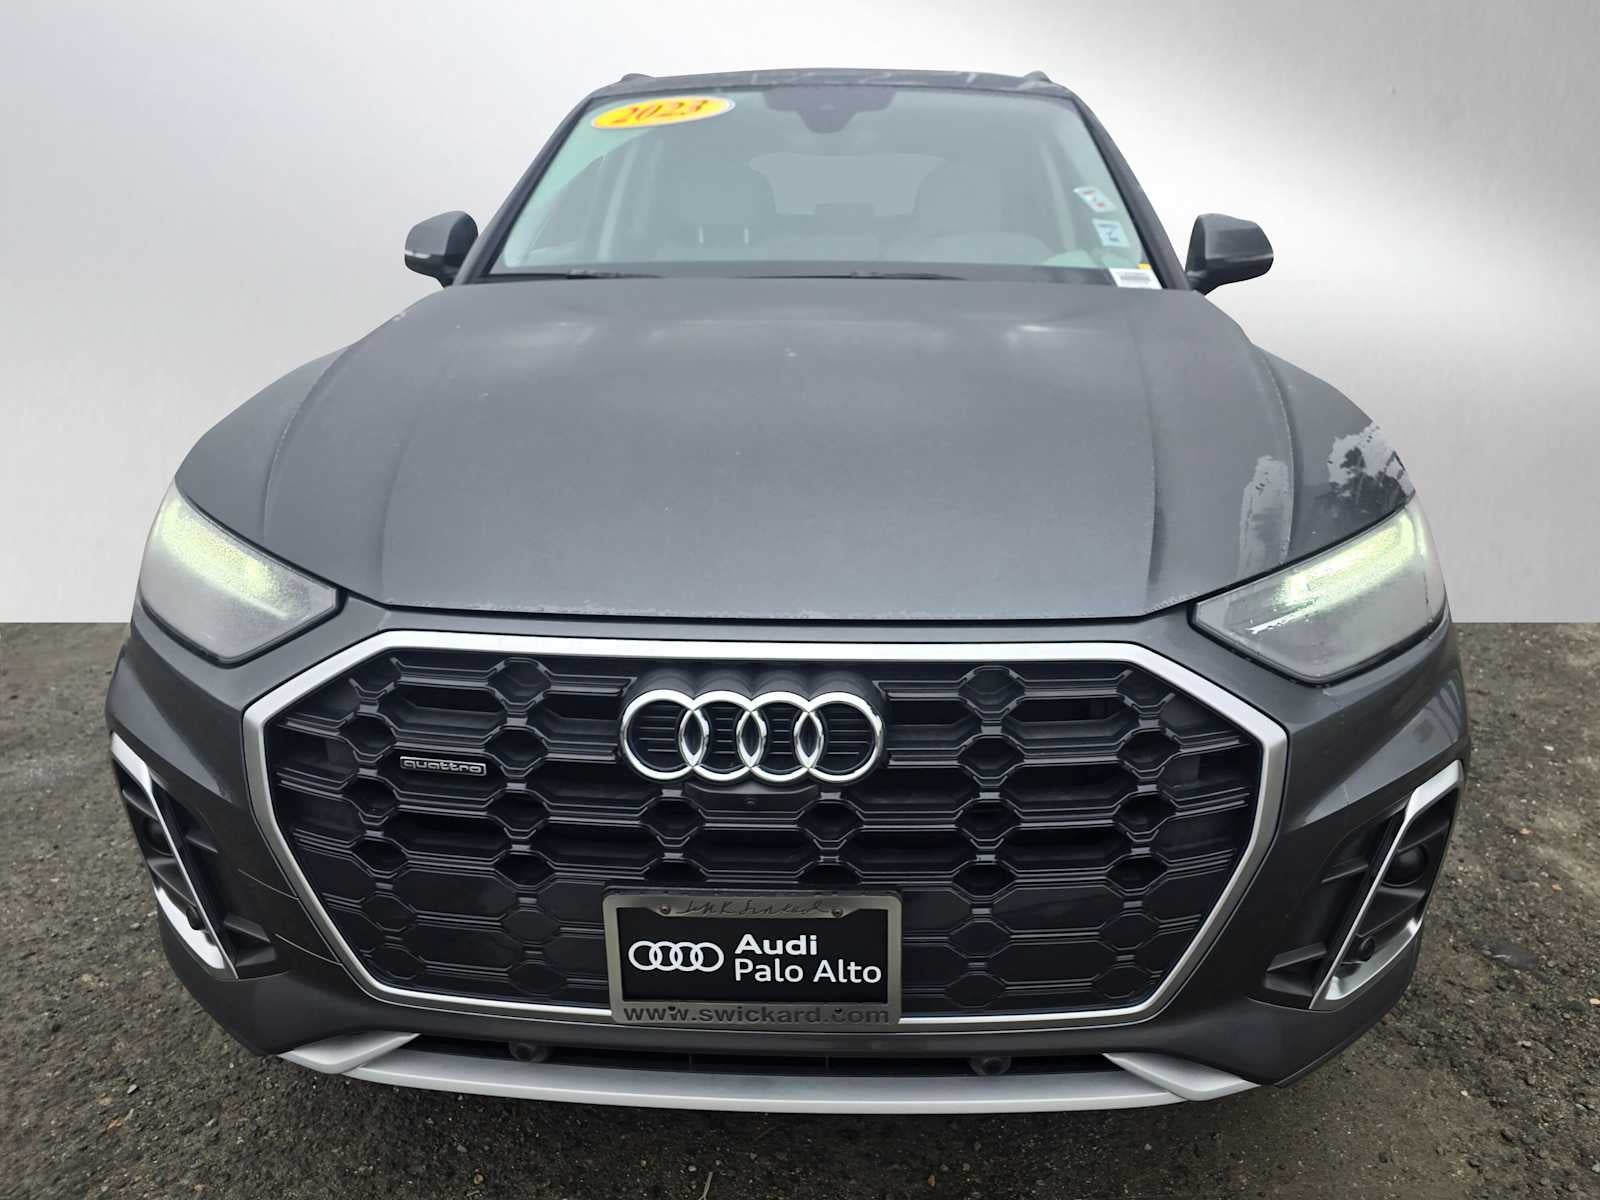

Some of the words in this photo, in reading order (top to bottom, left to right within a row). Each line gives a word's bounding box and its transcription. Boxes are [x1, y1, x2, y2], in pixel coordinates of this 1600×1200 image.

[610, 99, 709, 124] 2023
[403, 759, 482, 774] quattro
[734, 933, 818, 956] Audi
[734, 957, 804, 983] Palo
[812, 959, 882, 984] Alto
[623, 1005, 889, 1025] www.swickard.com
